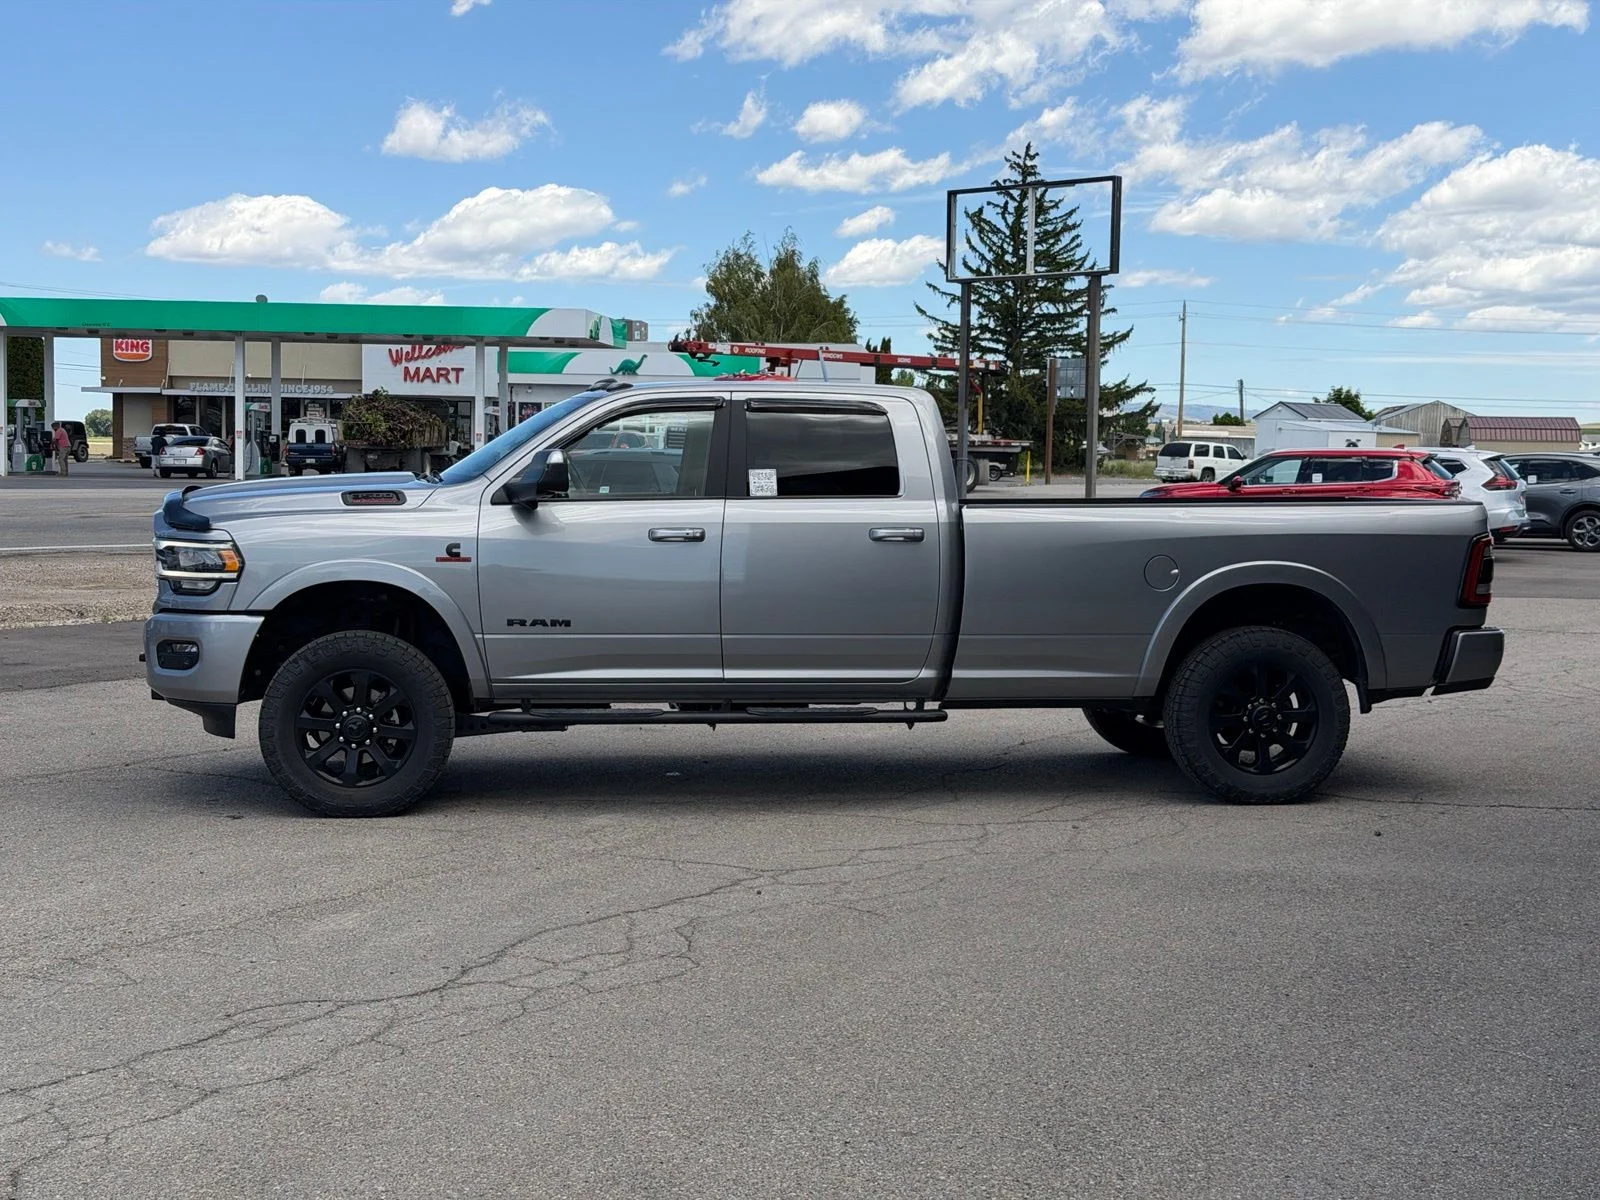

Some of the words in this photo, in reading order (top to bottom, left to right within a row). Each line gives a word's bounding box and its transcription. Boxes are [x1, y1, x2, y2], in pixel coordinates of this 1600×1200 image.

[115, 340, 150, 352] KING
[403, 366, 465, 384] MART
[189, 382, 224, 392] FLAME
[309, 385, 334, 394] 1954
[506, 618, 571, 627] RAM
